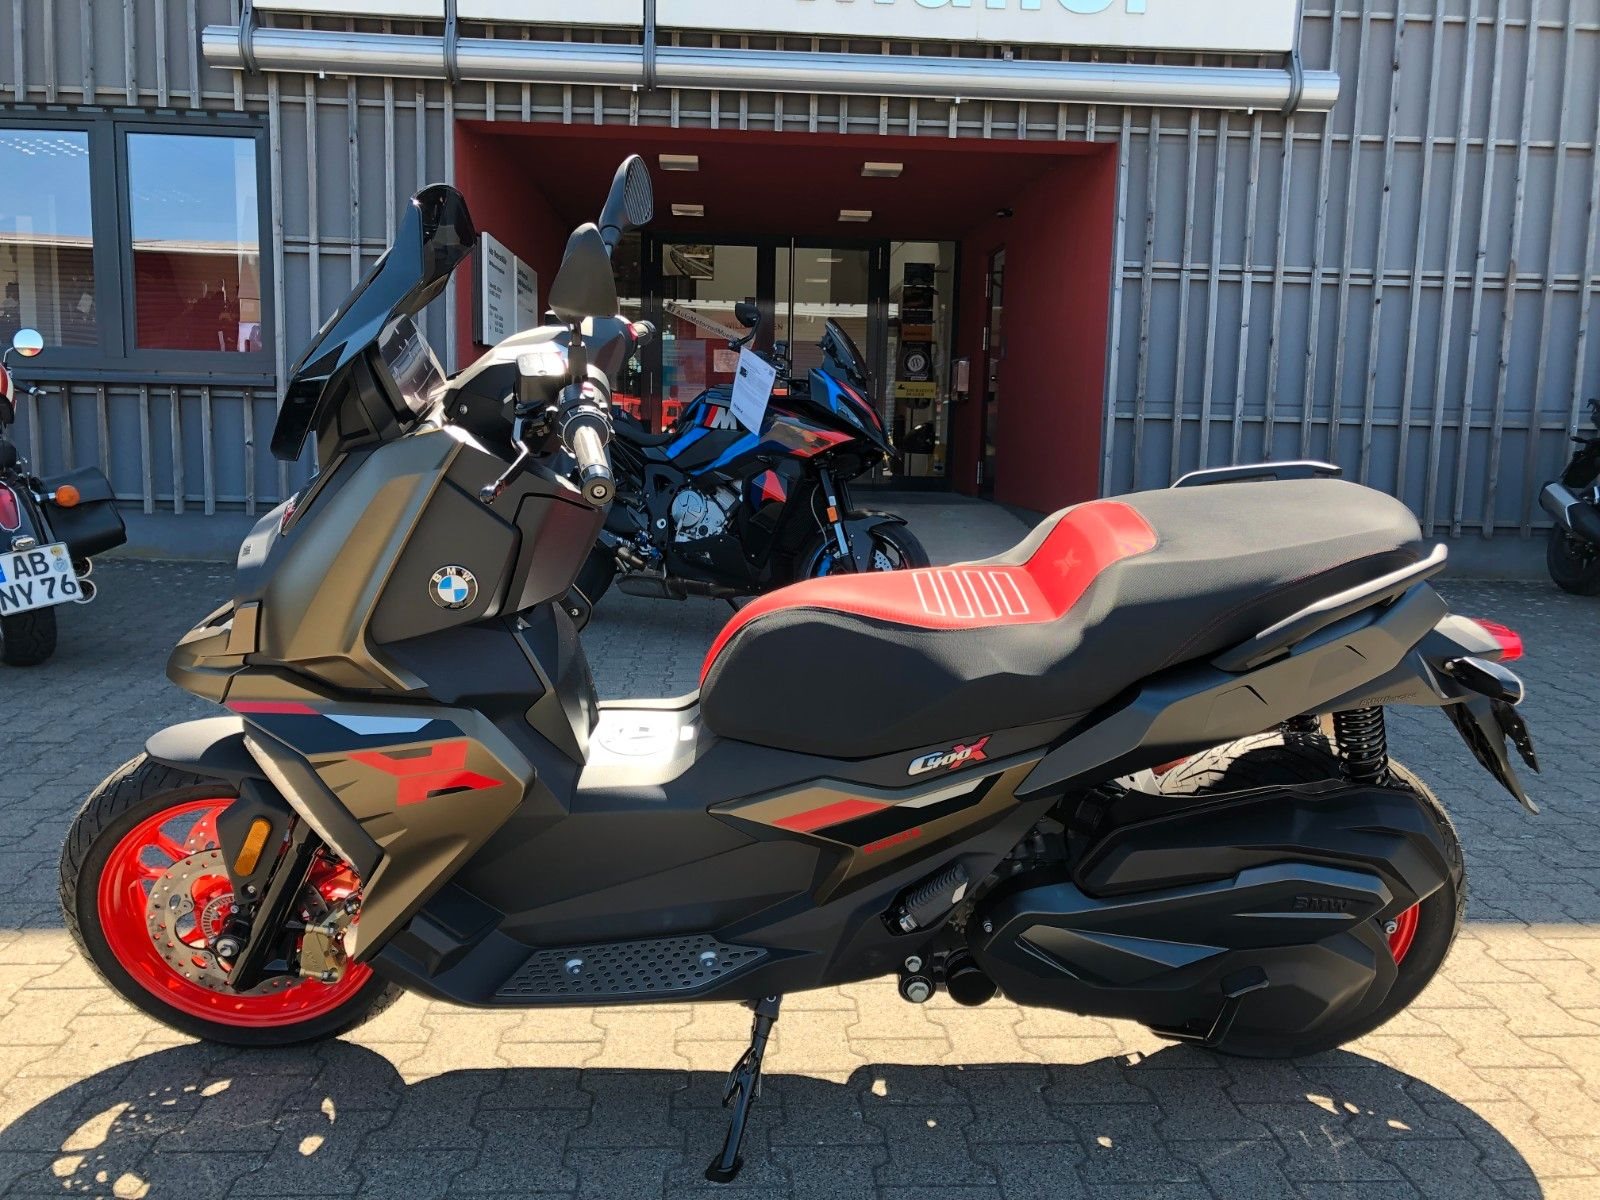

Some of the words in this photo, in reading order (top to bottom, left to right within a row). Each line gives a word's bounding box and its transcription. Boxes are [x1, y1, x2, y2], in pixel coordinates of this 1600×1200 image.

[13, 552, 50, 580] AB
[432, 567, 473, 583] BMW
[0, 581, 33, 611] NY
[40, 574, 77, 599] 76
